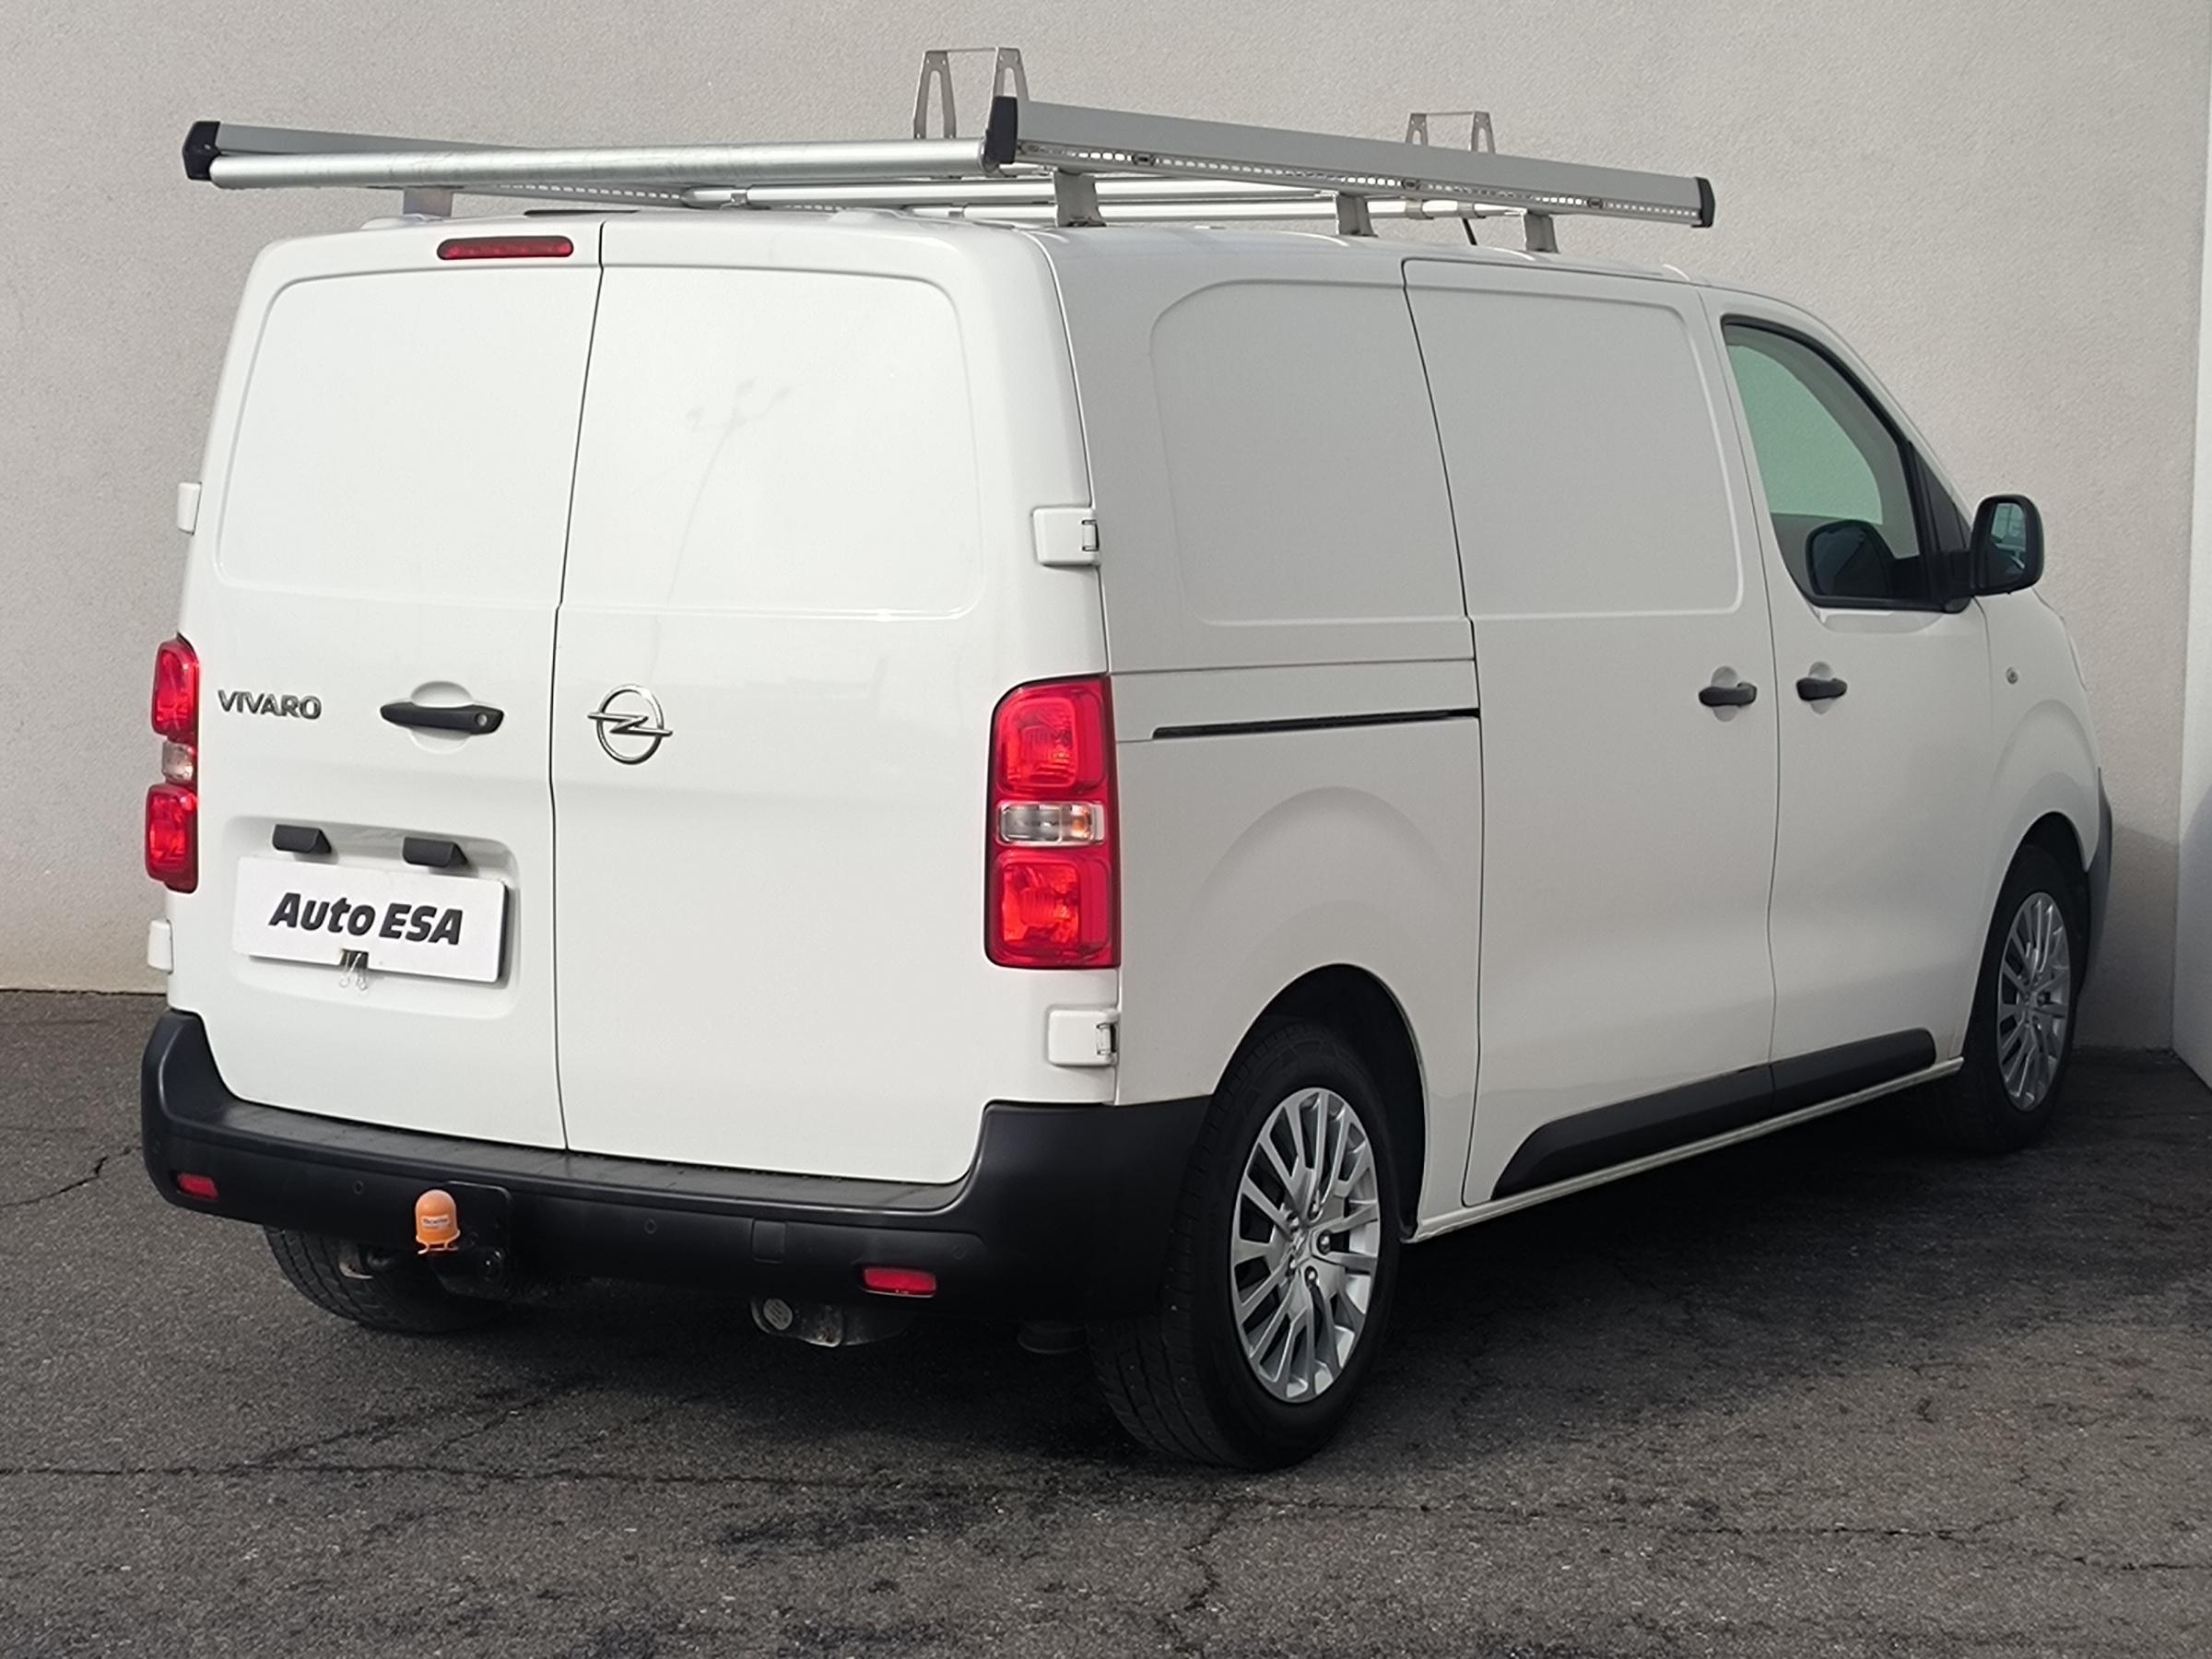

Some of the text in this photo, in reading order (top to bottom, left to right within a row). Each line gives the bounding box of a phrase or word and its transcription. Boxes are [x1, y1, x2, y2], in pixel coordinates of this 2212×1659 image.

[218, 689, 322, 720] VIVARO
[268, 892, 463, 946] Auto ESA
